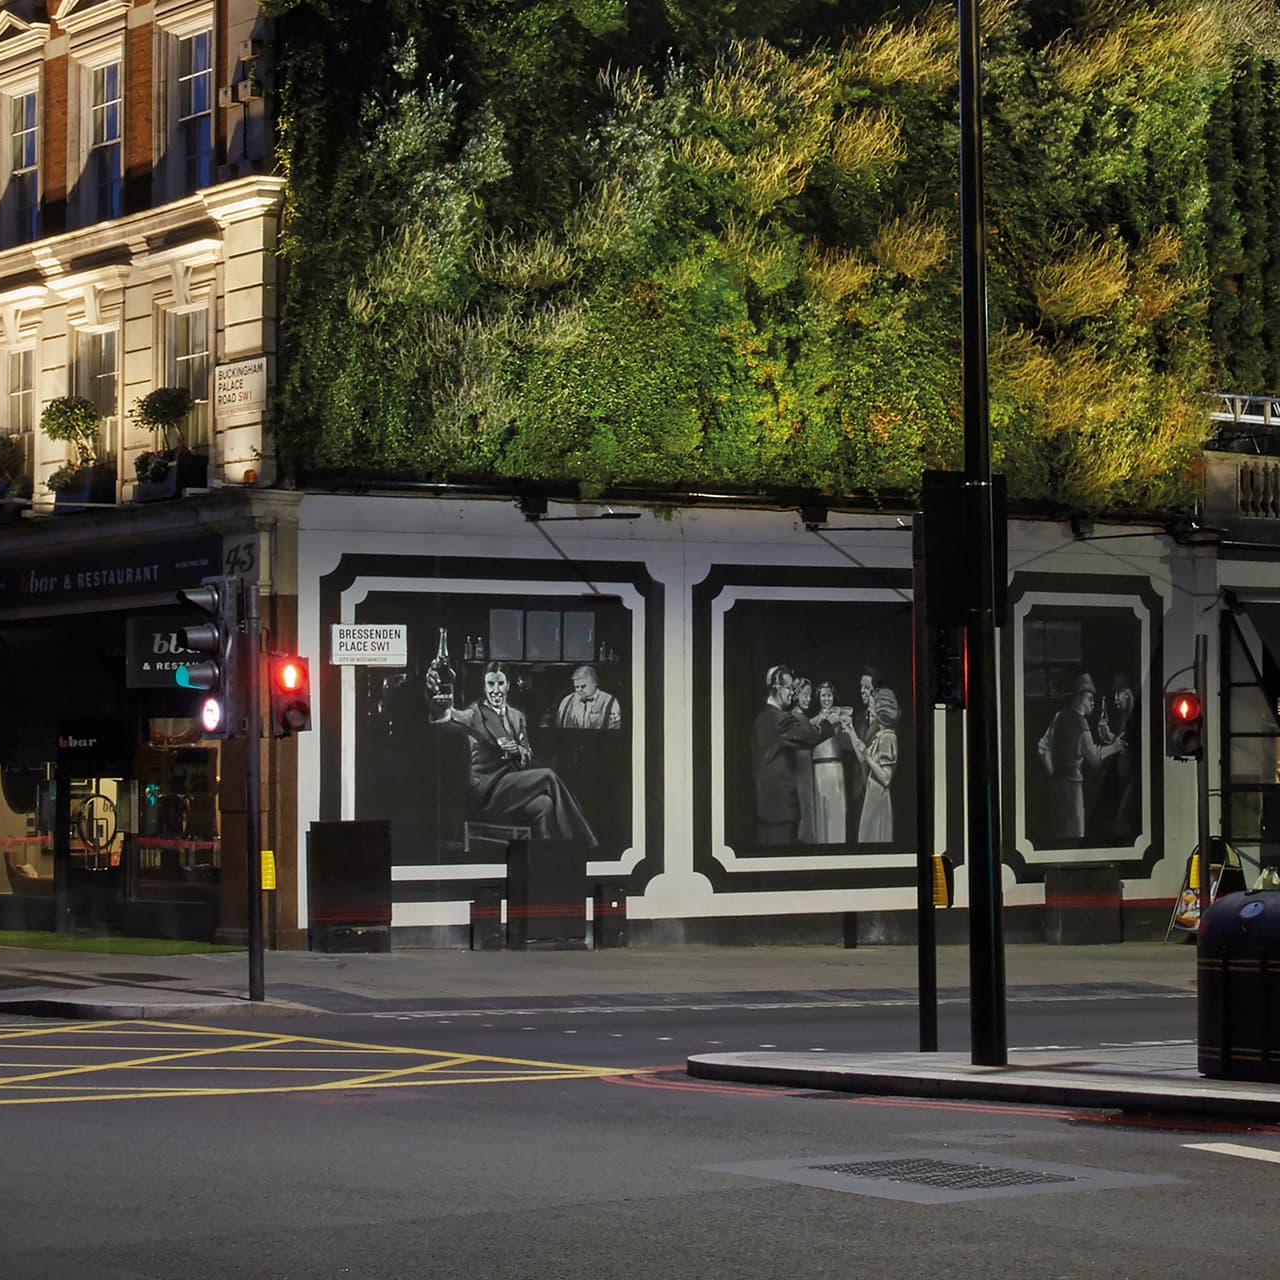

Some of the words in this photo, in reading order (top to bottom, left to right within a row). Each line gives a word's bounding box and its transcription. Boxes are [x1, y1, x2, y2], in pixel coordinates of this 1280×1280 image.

[218, 362, 264, 380] BUCKINGHAM
[218, 378, 244, 392] PALACE
[218, 393, 237, 405] ROAD
[238, 390, 253, 402] SW1
[225, 542, 256, 578] 43
[63, 574, 72, 589] &
[77, 564, 160, 588] RESTAURANT
[338, 628, 401, 640] BRESSENDEN
[338, 640, 369, 652] PLACE
[370, 640, 390, 652] SW1
[142, 662, 151, 670] &
